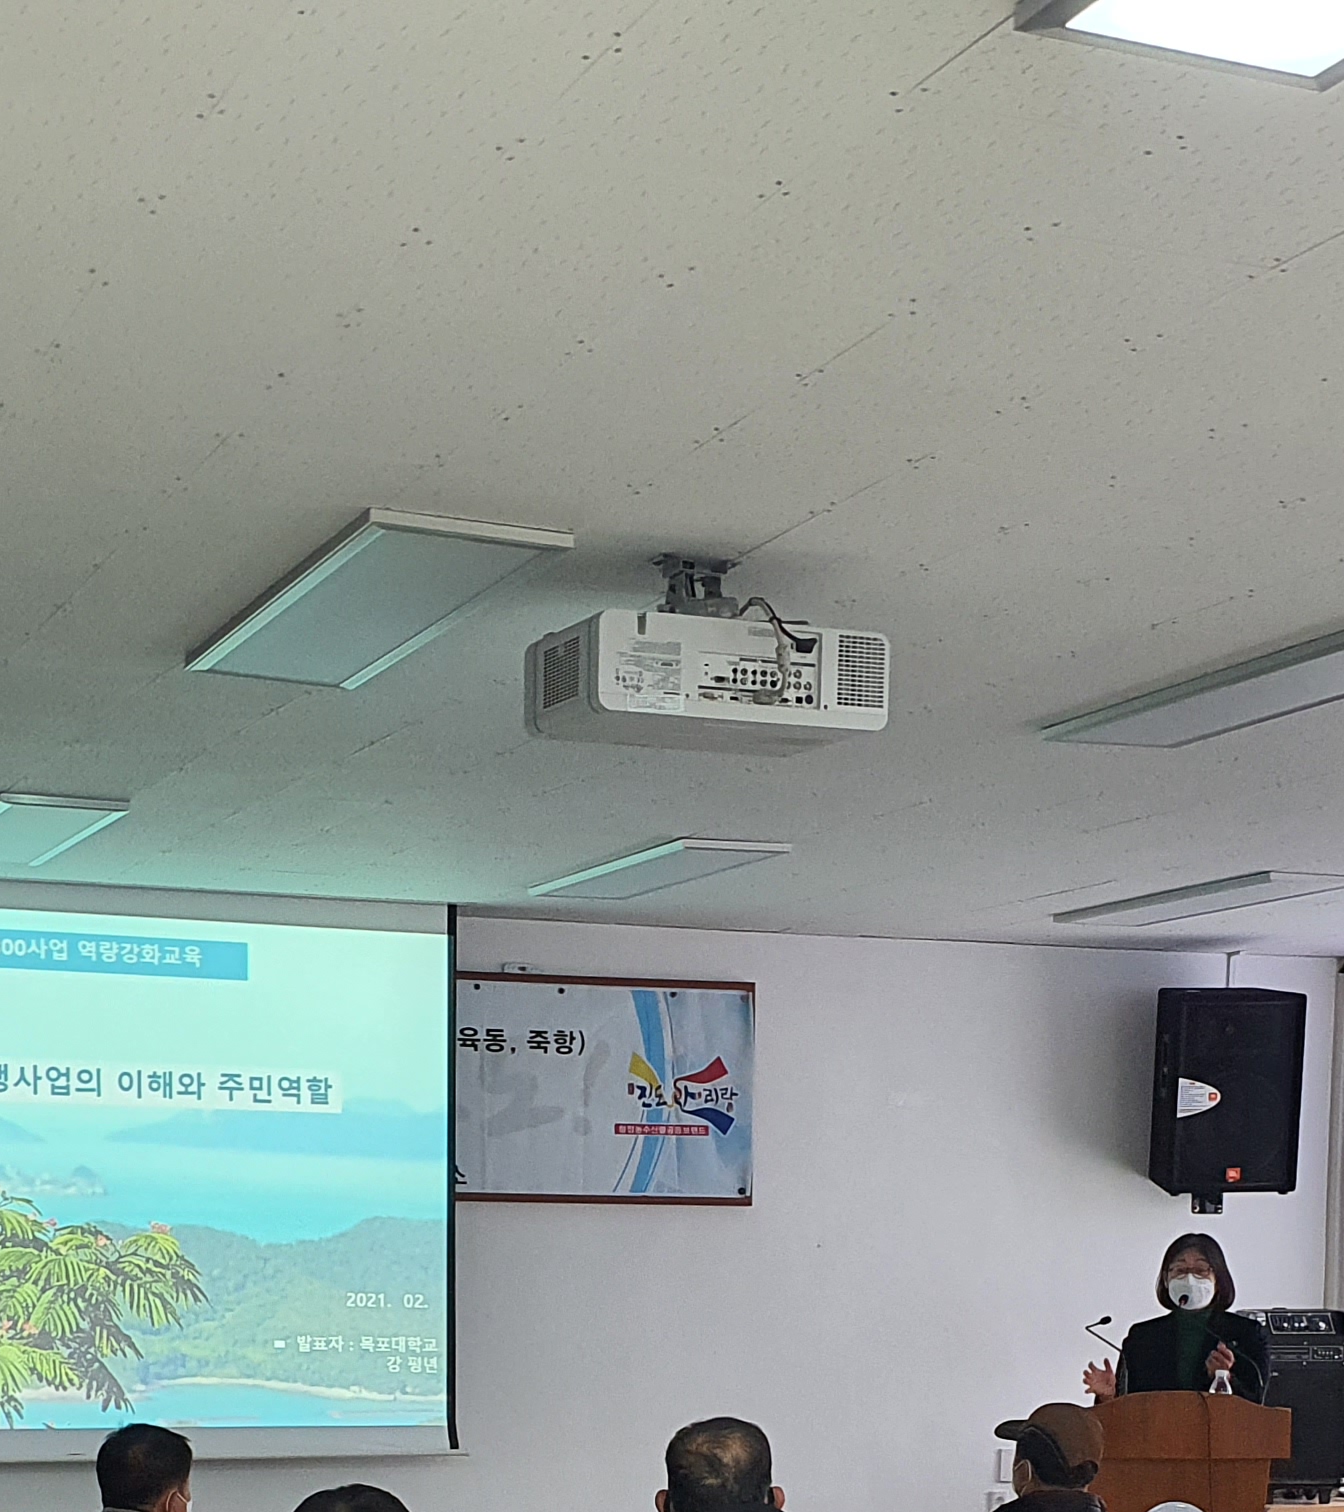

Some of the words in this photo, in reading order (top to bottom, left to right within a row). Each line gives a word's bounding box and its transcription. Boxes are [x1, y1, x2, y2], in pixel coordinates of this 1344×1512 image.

[77, 940, 203, 968] 역량강화교육
[457, 1025, 516, 1054] 육동,
[526, 1029, 586, 1056] 죽항)
[117, 1068, 205, 1101] 이해와
[217, 1072, 333, 1106] 주민역할
[346, 1292, 392, 1308] 2021.
[403, 1294, 429, 1309] 02.
[296, 1335, 344, 1353] 발표자
[359, 1336, 439, 1354] 목포대학교
